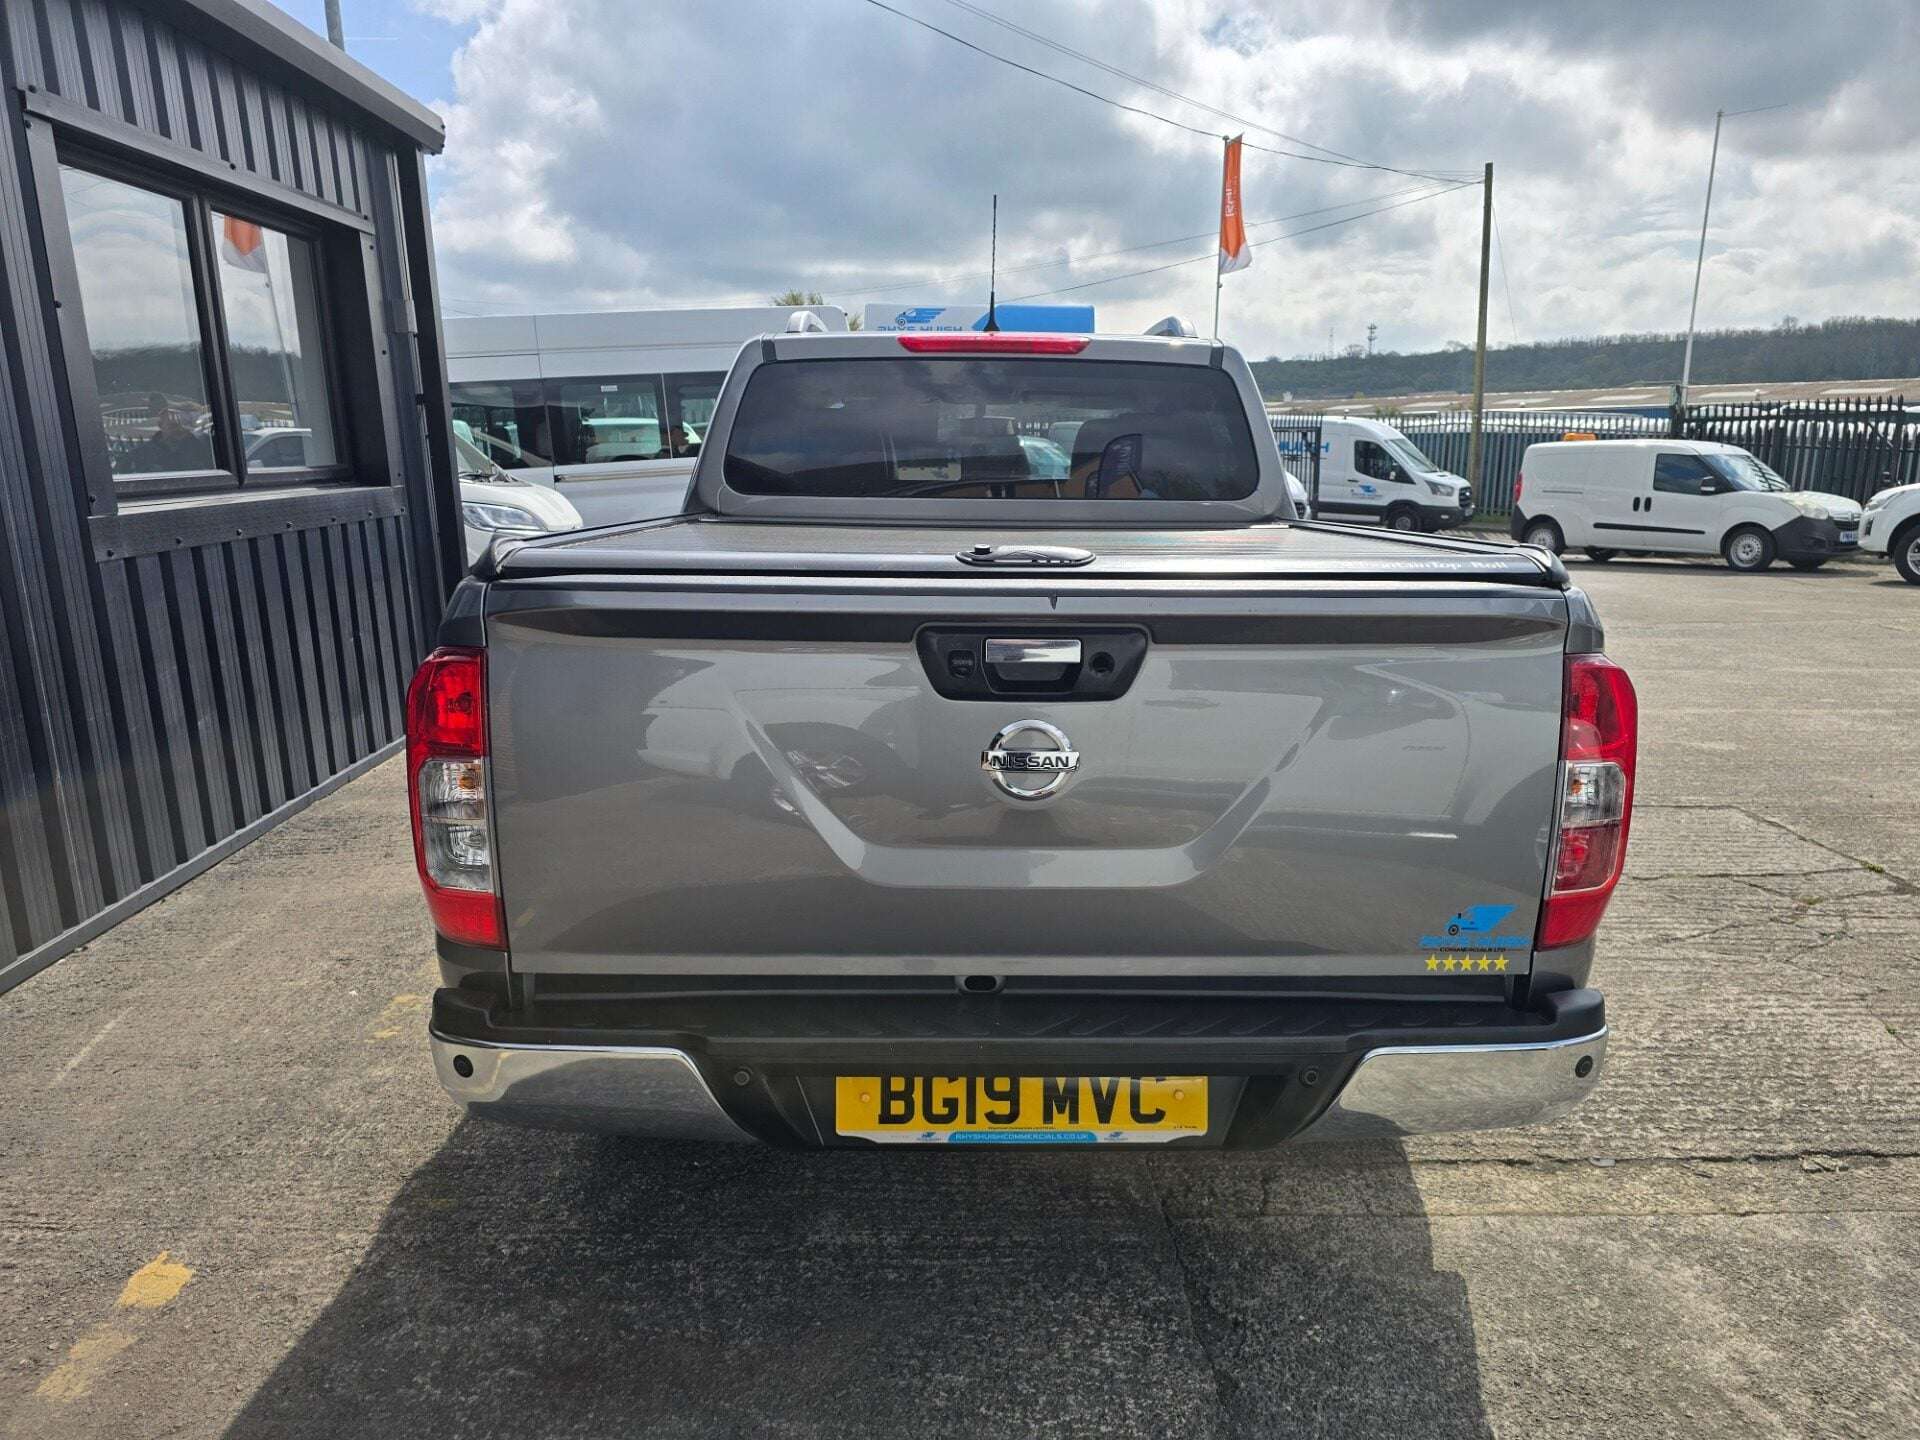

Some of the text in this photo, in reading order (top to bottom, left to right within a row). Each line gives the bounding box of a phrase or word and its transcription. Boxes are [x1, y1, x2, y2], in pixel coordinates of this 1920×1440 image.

[992, 755, 1069, 768] NISSAN
[878, 1076, 1167, 1125] BG19 MVC
